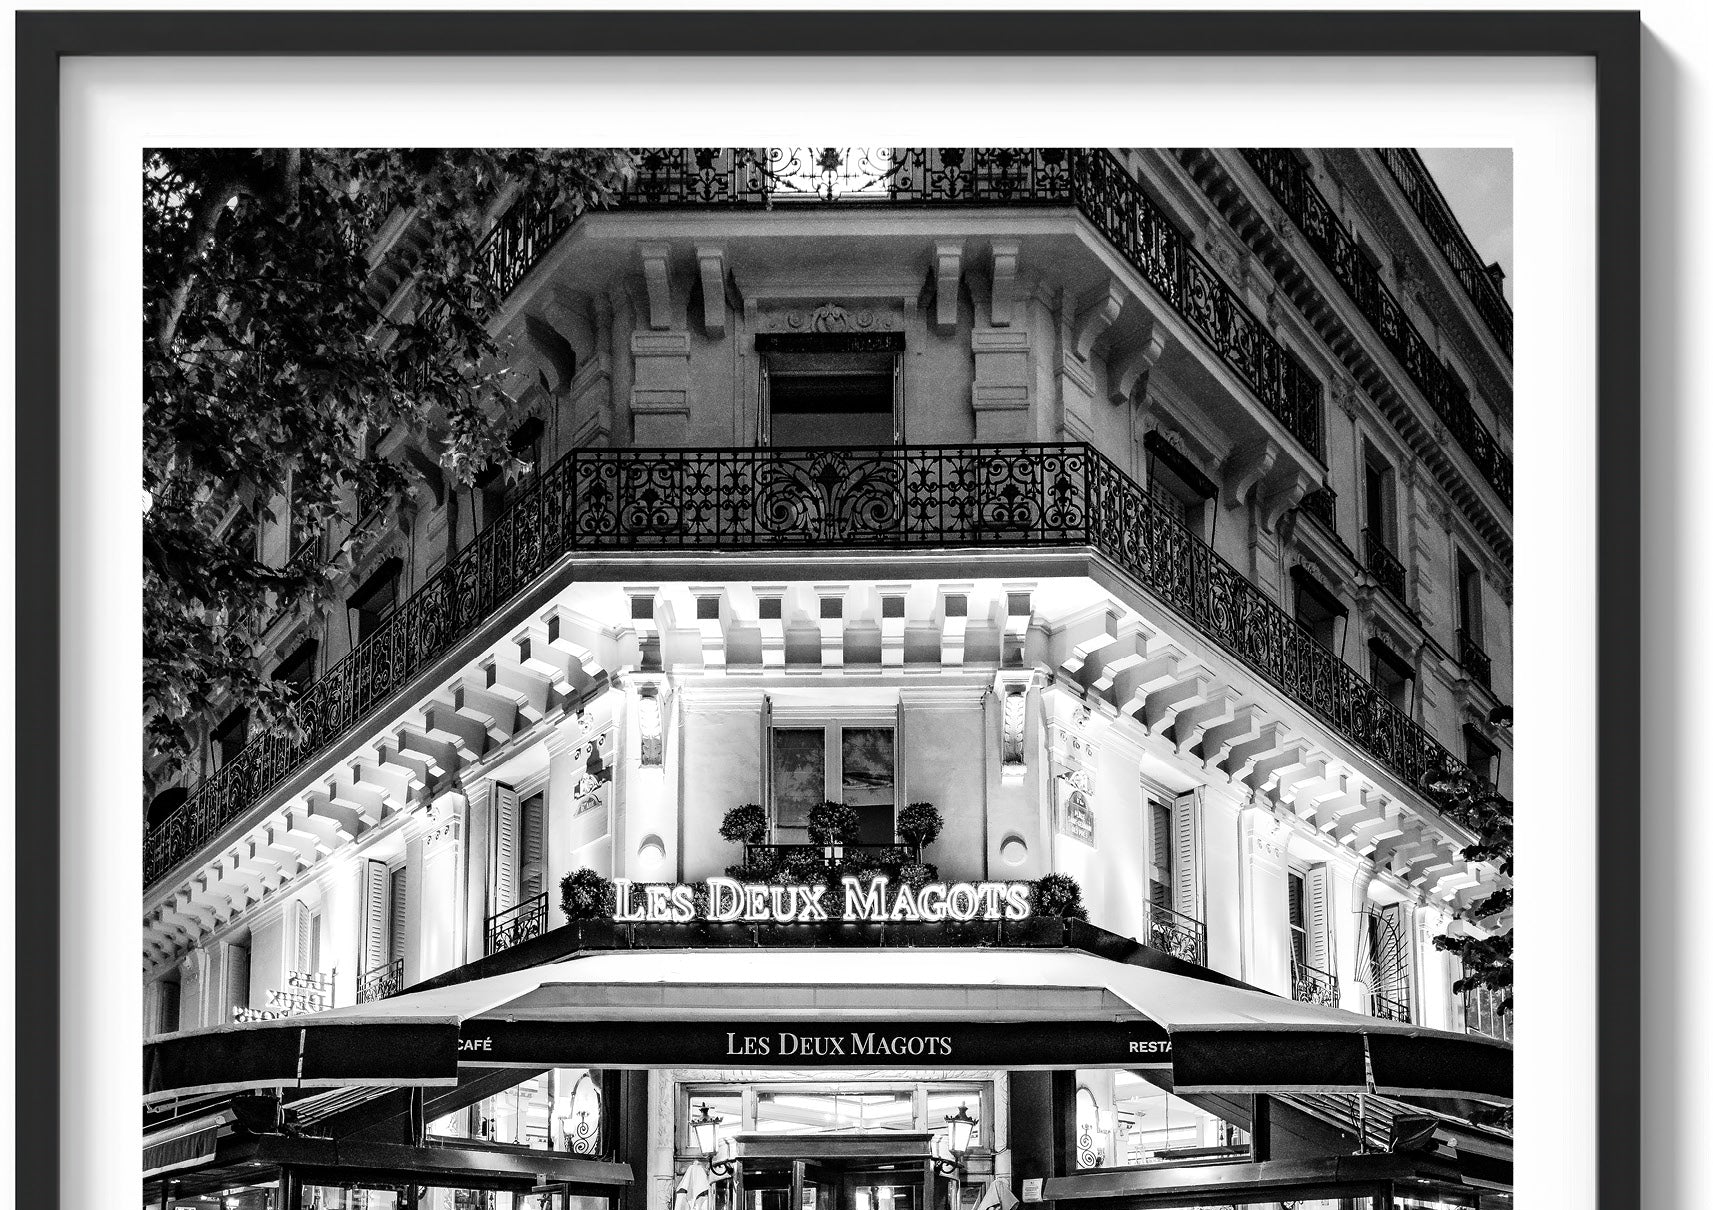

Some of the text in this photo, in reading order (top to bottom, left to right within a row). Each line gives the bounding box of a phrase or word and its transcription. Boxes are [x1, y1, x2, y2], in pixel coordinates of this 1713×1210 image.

[613, 875, 1030, 922] LES DEUX MAGOTS
[457, 1036, 493, 1051] CAFÉ
[726, 1032, 952, 1055] LES DEUX MAGOTS
